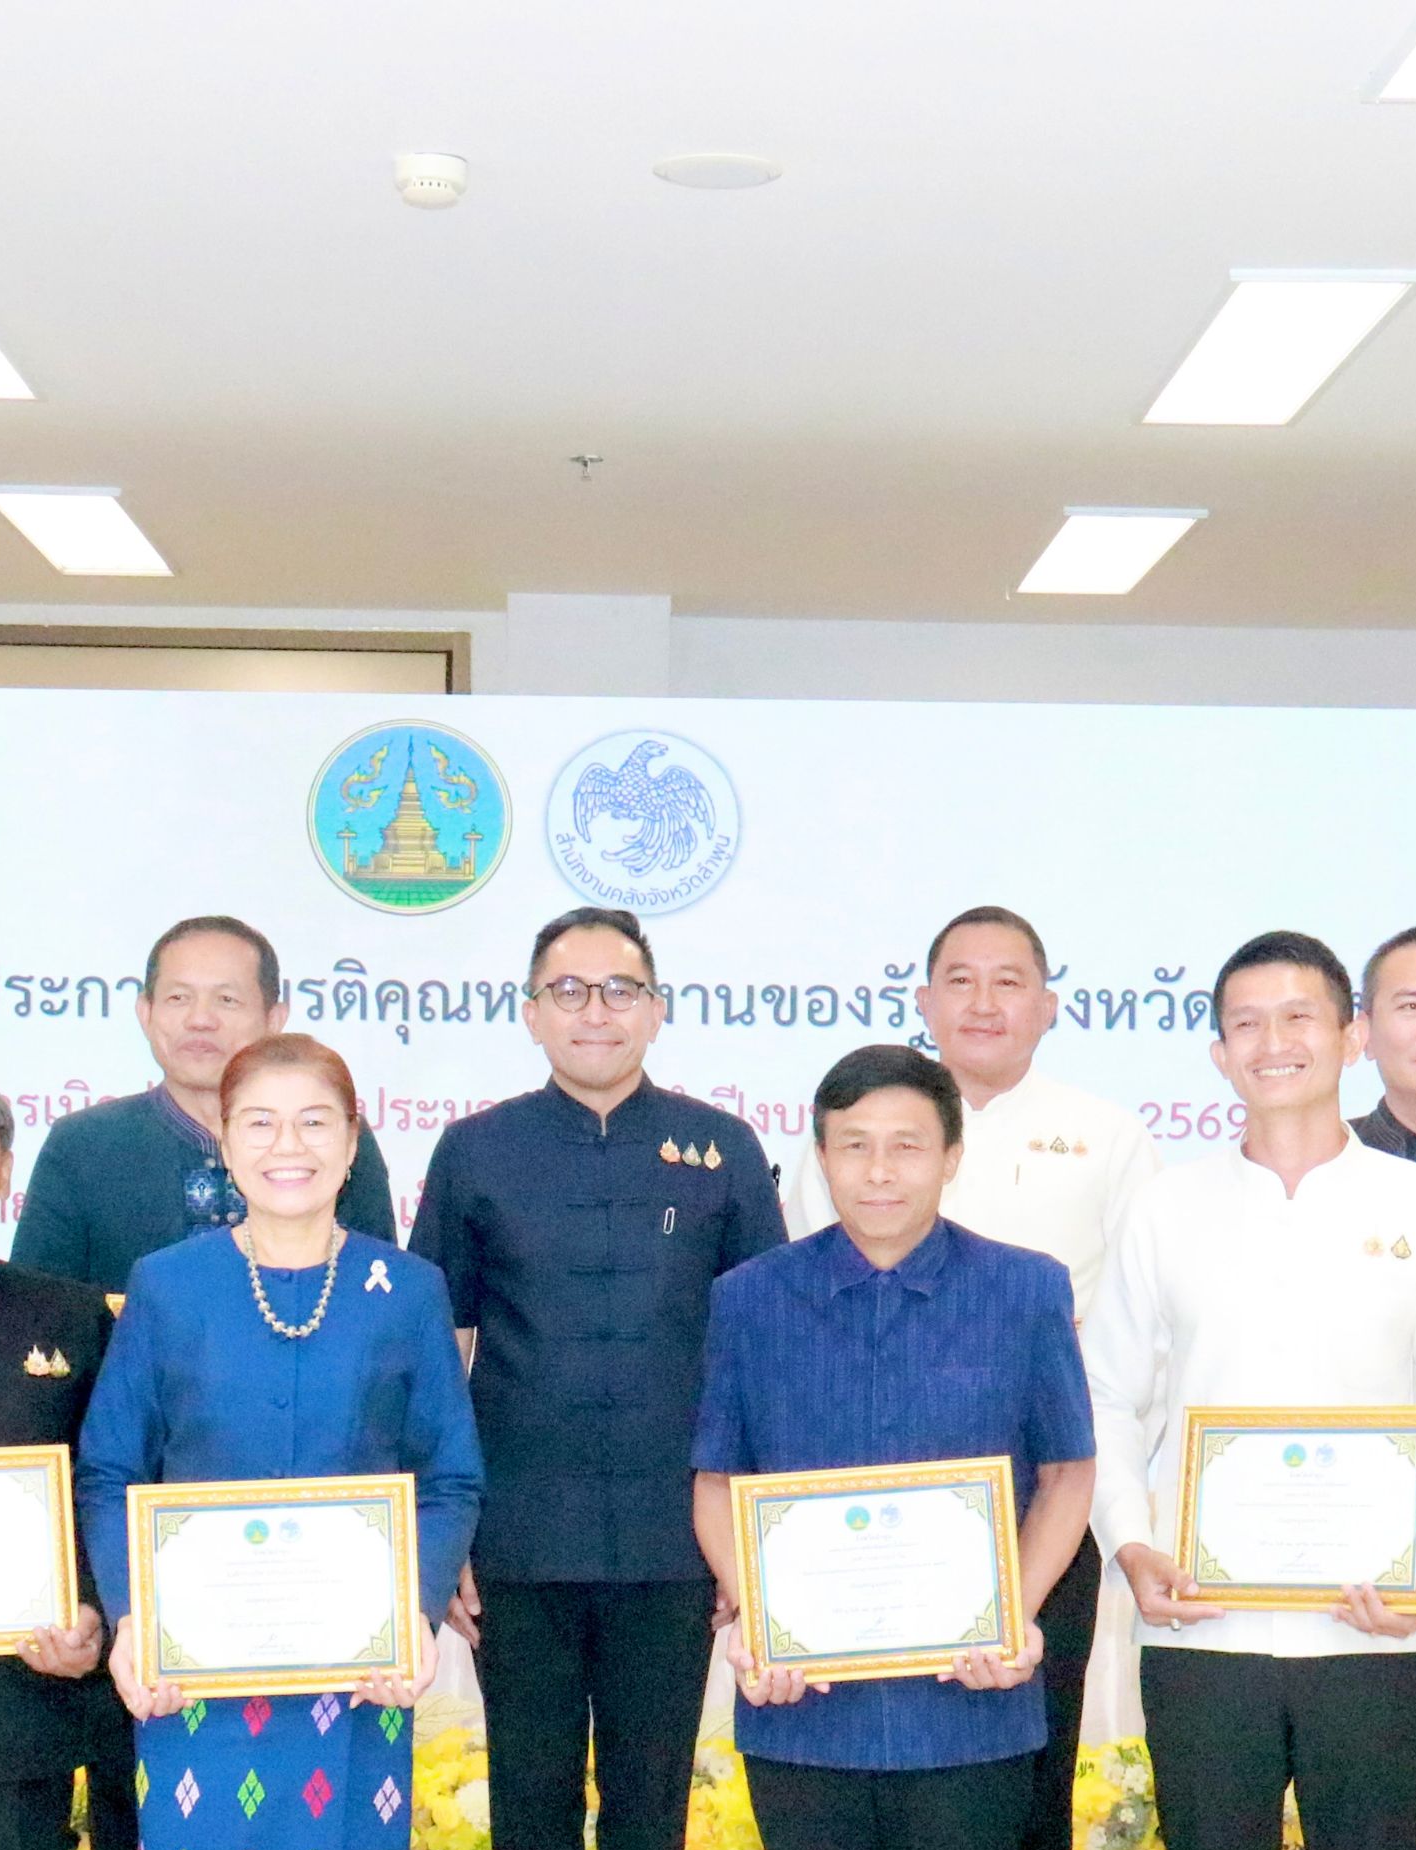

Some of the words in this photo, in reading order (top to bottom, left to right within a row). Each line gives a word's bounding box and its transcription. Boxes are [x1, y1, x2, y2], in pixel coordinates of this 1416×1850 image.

[556, 832, 732, 906] สำนักงานคลังจังหวัดลำพูน
